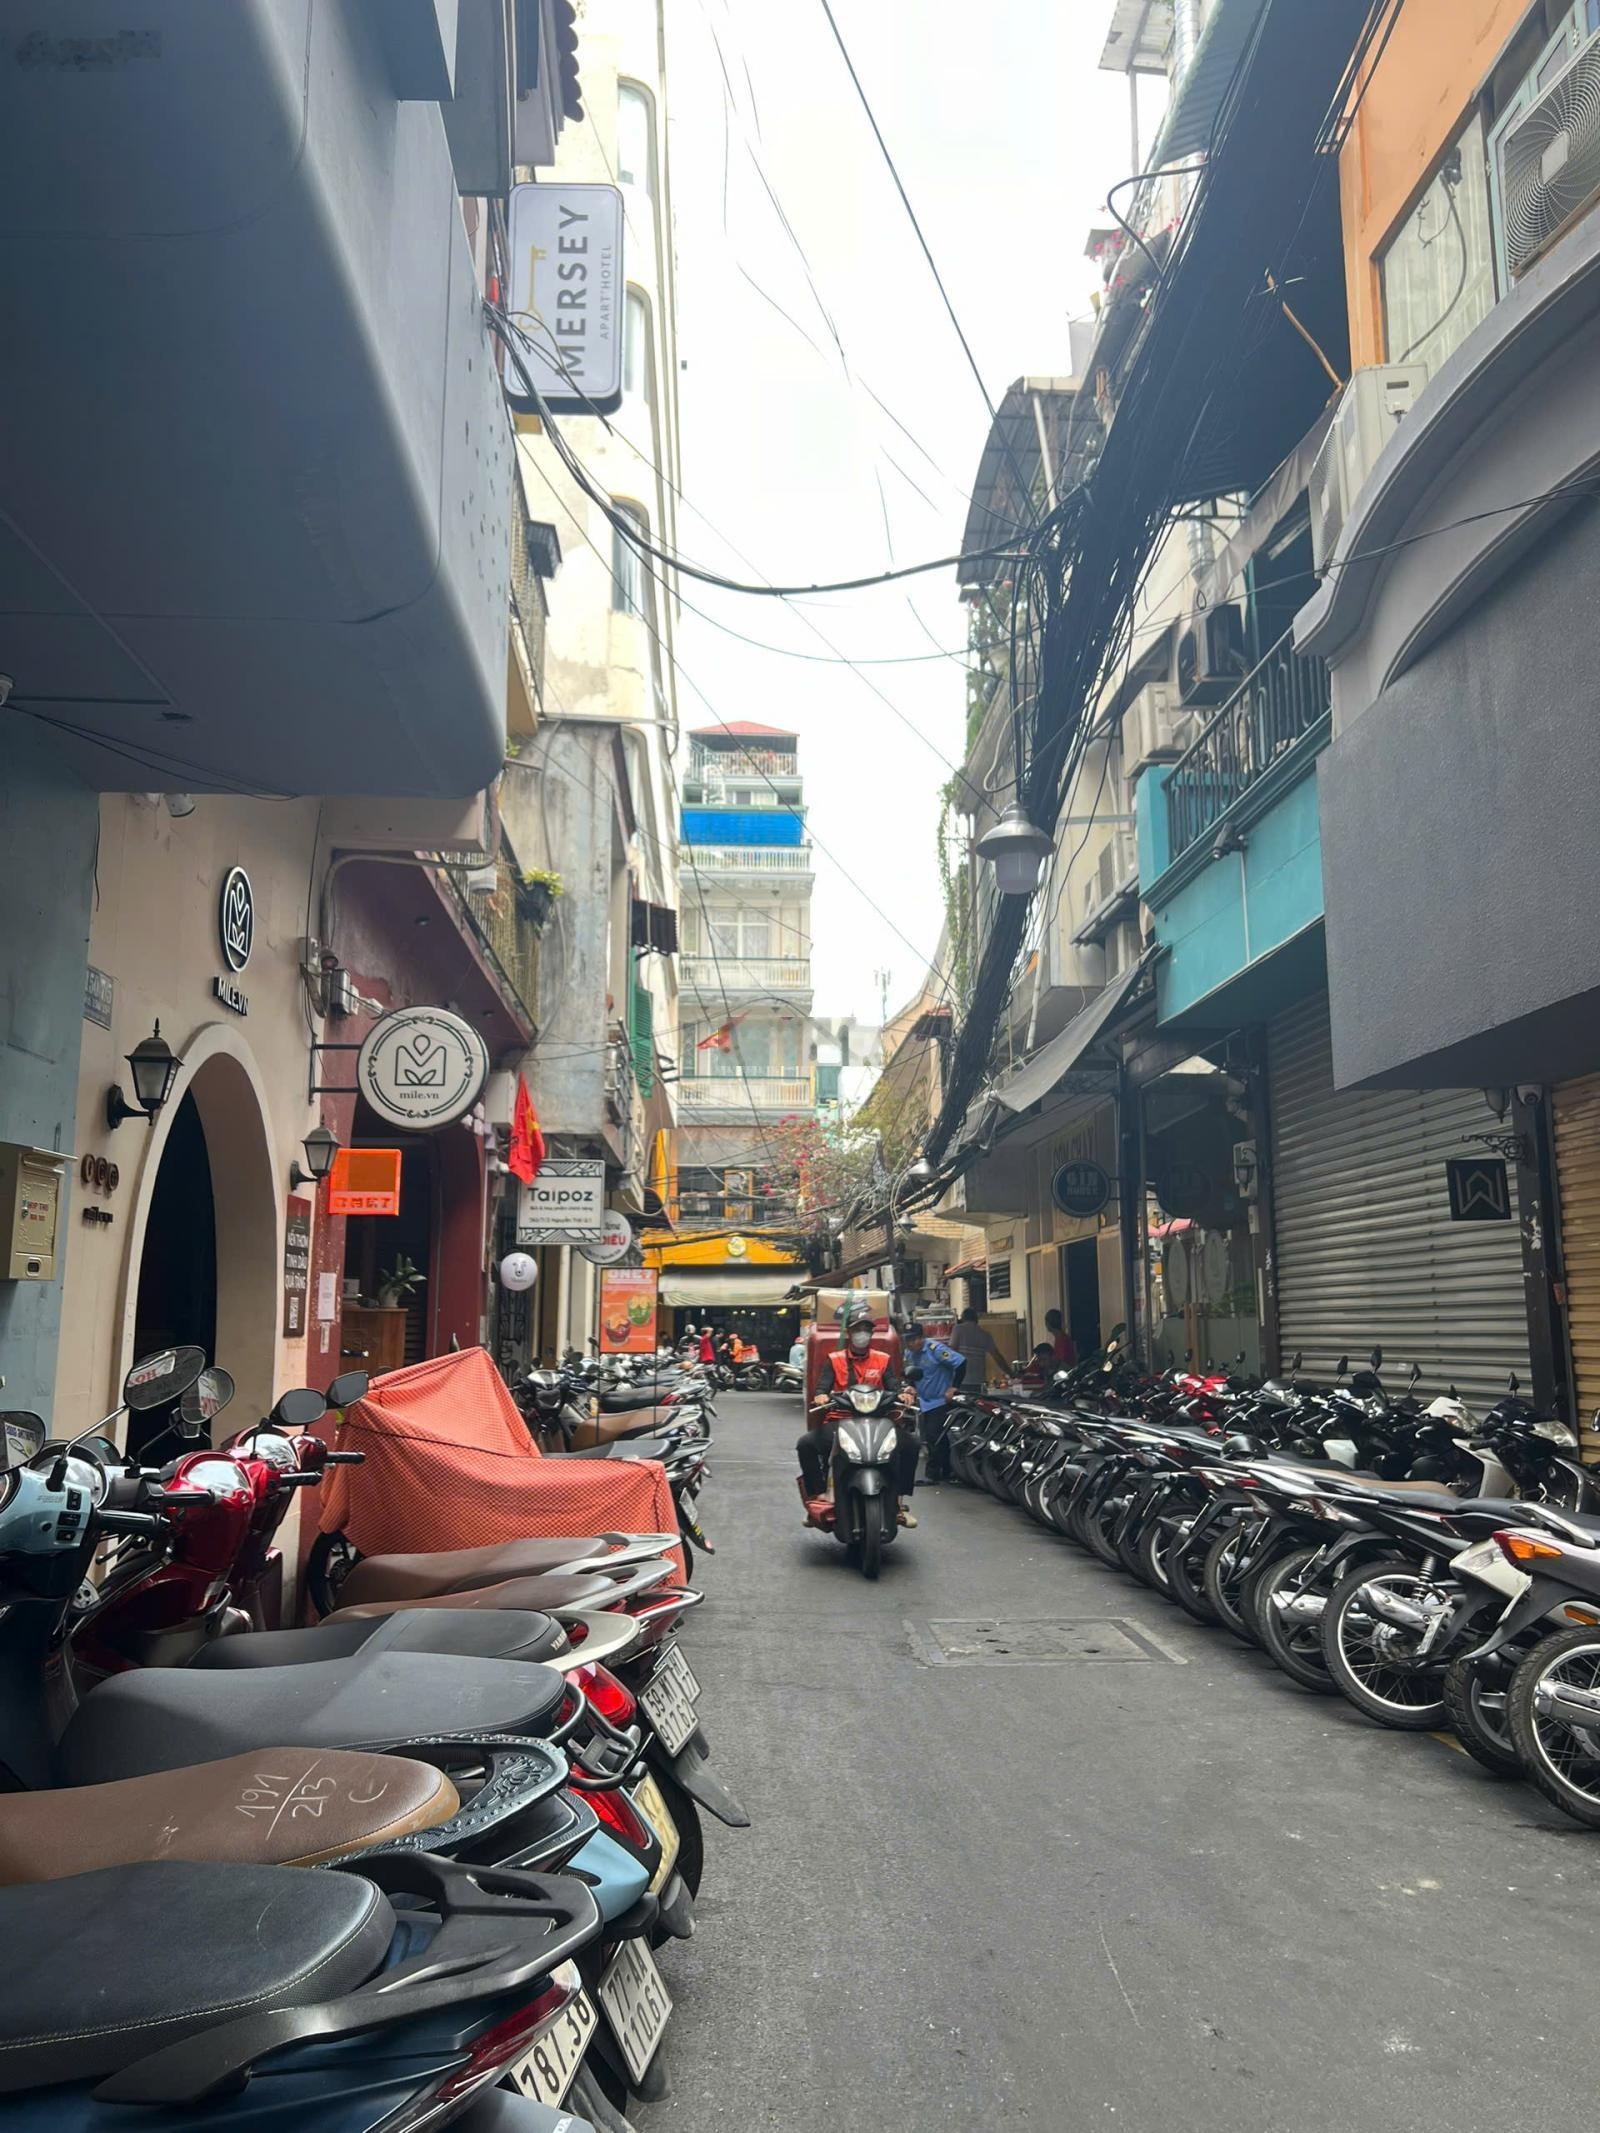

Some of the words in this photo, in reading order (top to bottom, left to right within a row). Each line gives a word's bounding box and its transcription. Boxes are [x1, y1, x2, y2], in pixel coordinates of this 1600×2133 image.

[556, 205, 589, 377] MERSEY
[399, 1090, 439, 1099] mile.vn
[528, 1187, 593, 1204] Taipoz
[660, 1699, 696, 1749] 917.62
[623, 1972, 668, 2072] 110.61
